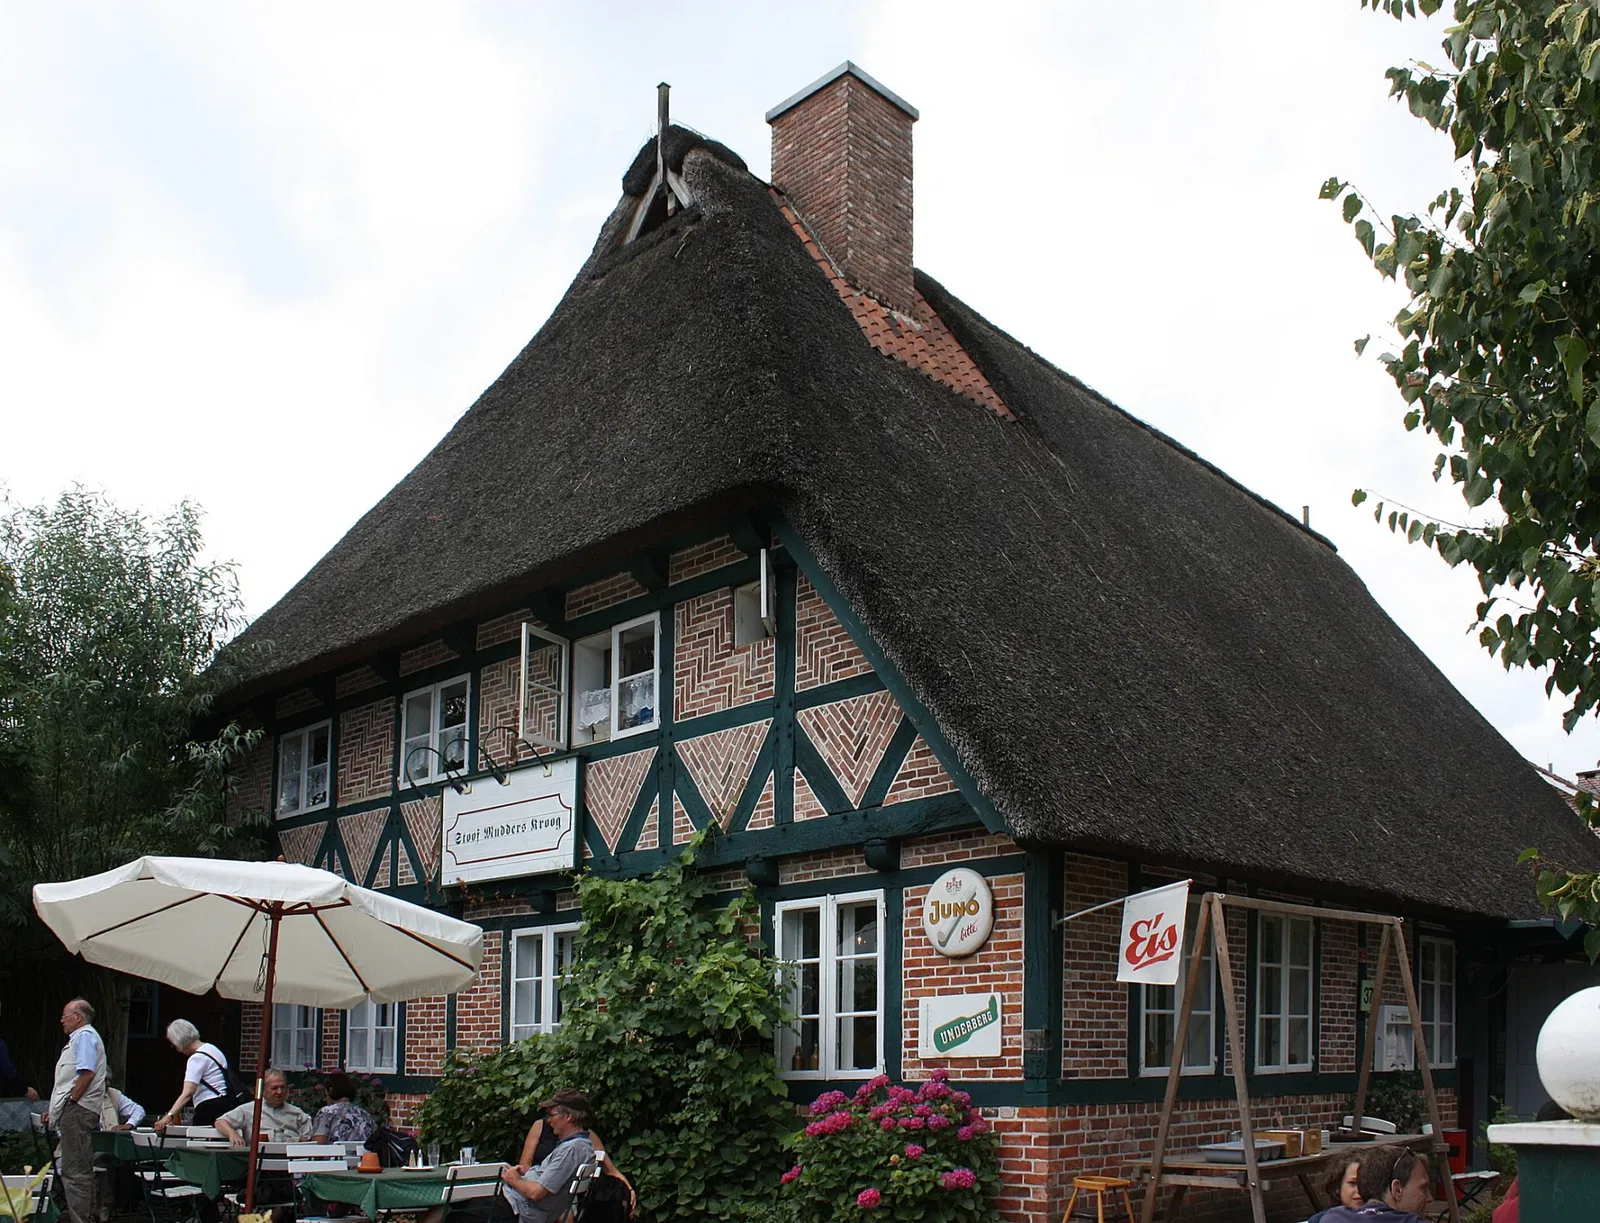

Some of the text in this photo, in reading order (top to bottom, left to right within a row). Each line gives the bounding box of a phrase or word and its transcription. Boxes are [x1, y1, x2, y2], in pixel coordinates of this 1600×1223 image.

[484, 823, 526, 839] Mudders
[531, 817, 561, 831] Kroog
[929, 899, 979, 925] JUNO
[1125, 912, 1177, 965] Eis
[940, 1011, 993, 1044] UNDERBERG
